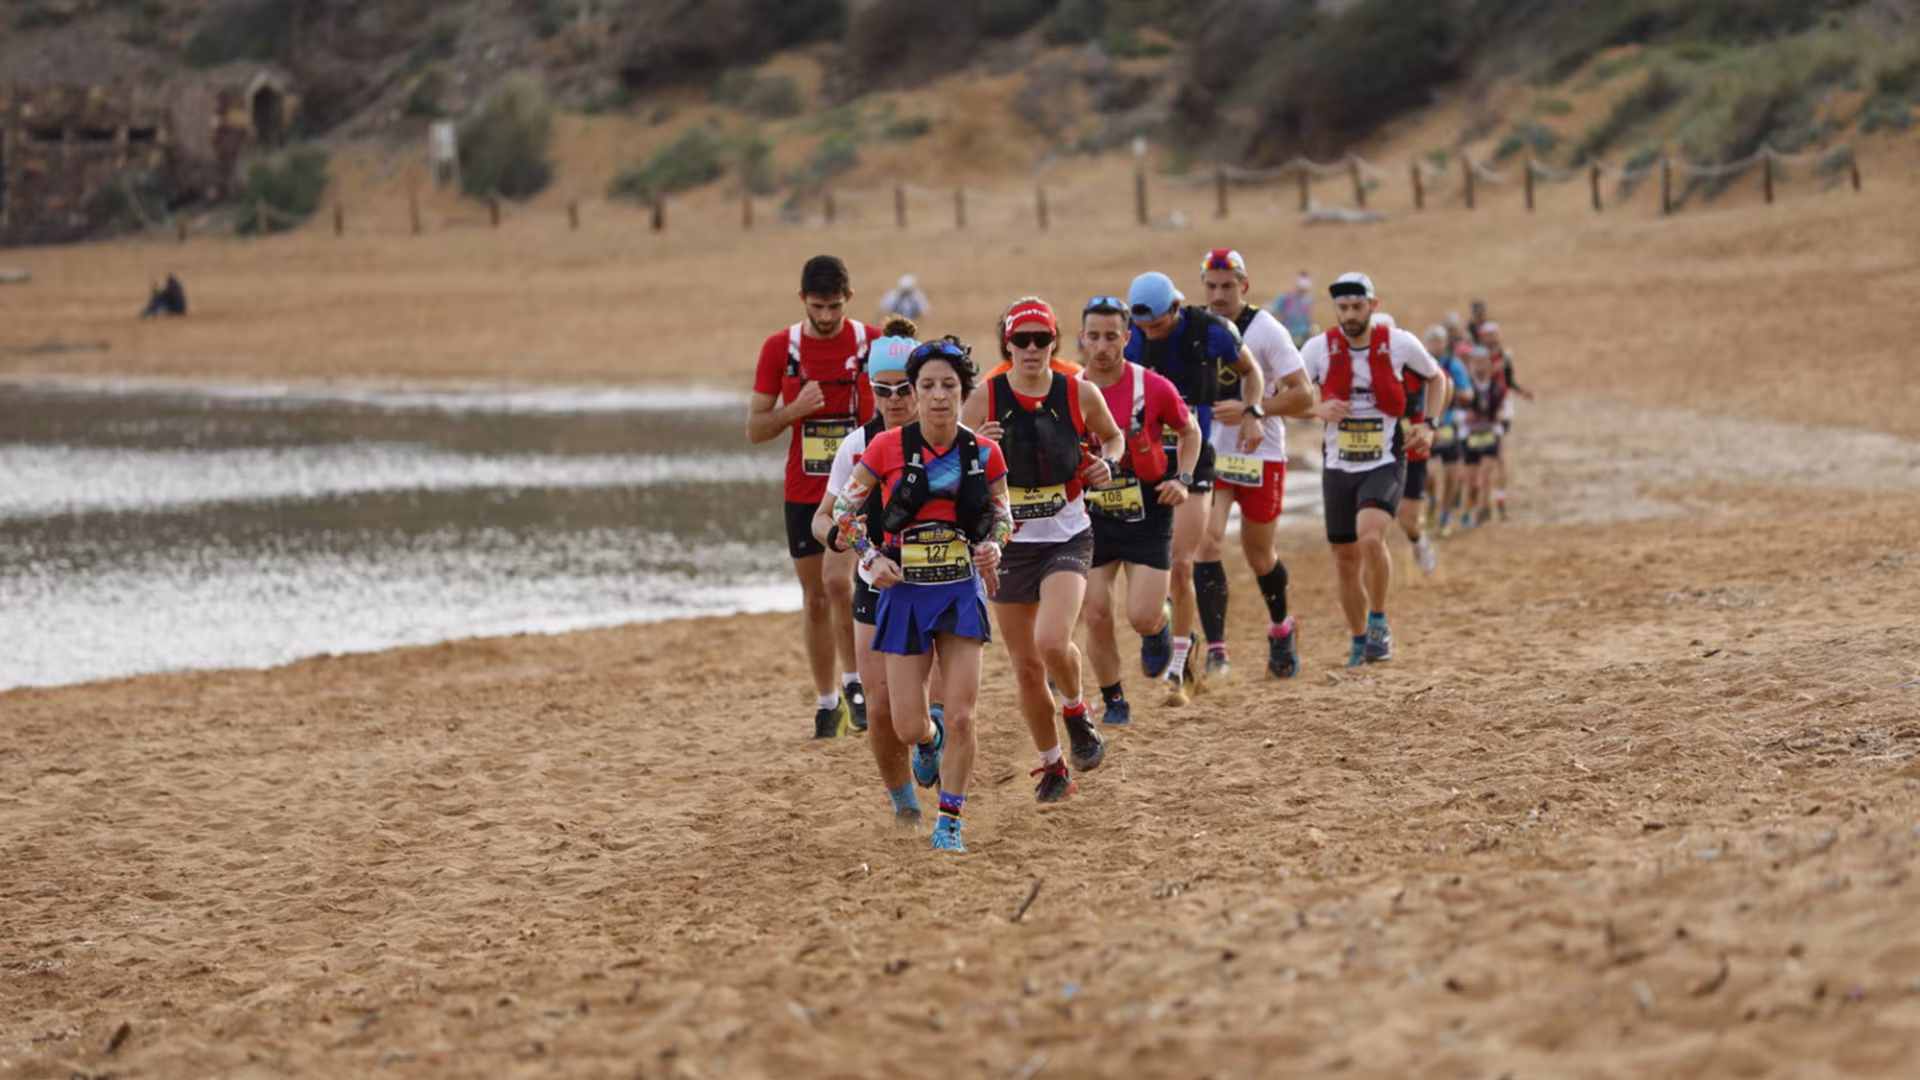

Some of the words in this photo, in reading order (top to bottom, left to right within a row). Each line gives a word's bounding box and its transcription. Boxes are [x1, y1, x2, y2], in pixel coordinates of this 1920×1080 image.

[823, 439, 837, 452] 98
[1101, 490, 1122, 504] 108
[924, 544, 949, 560] 127
